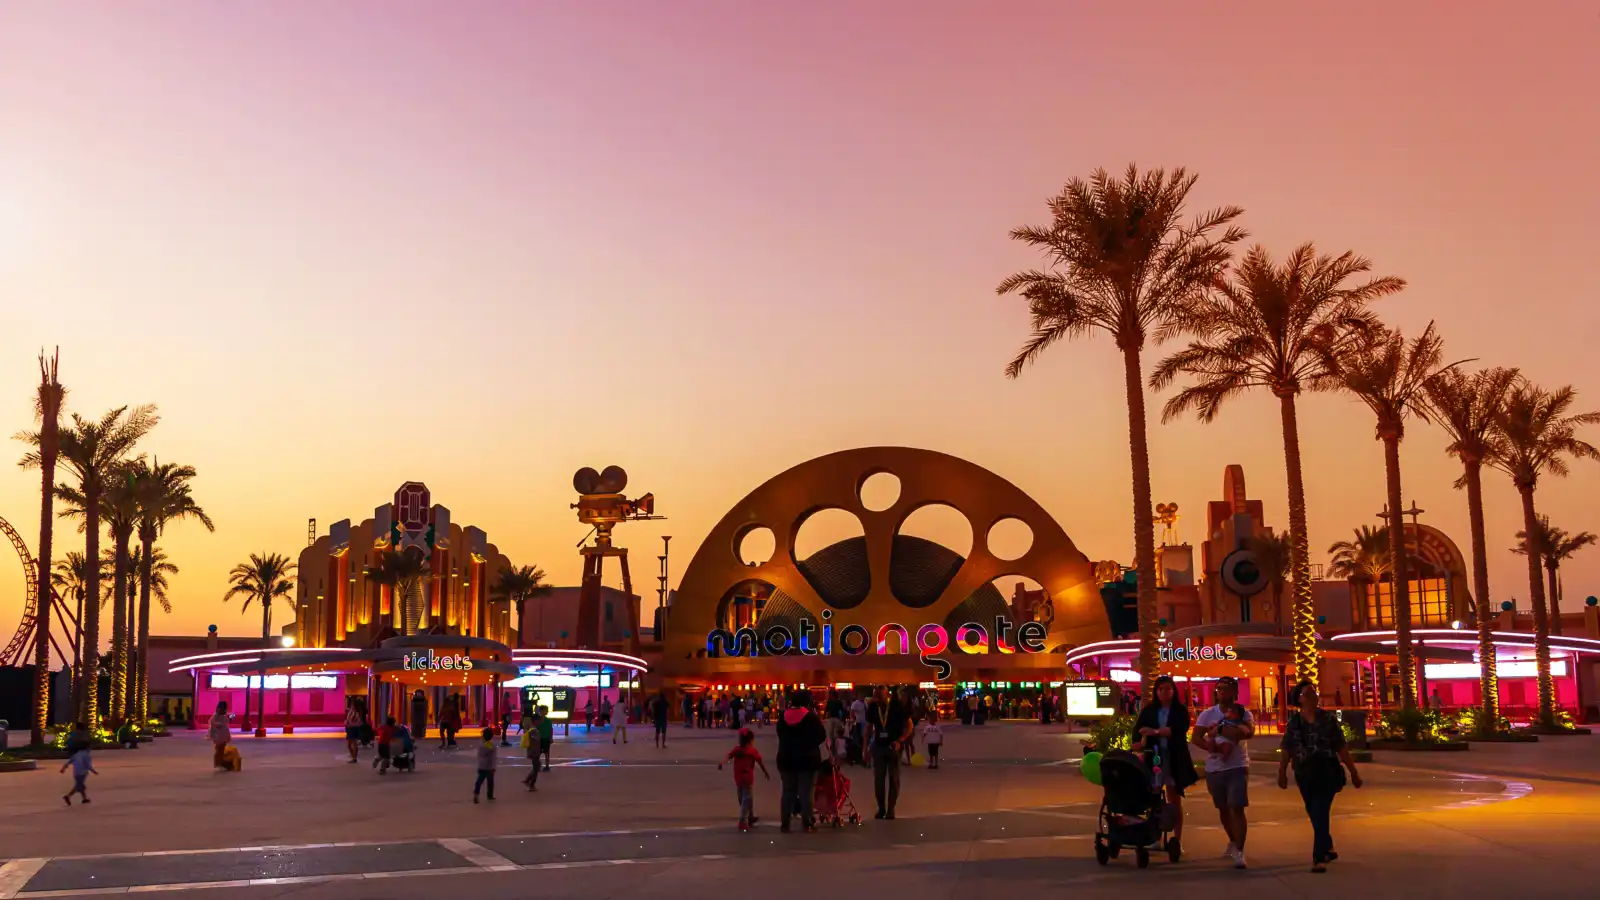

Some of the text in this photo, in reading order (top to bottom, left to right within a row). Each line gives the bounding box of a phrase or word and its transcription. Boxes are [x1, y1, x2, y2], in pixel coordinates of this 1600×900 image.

[707, 608, 1048, 680] motiongate
[1159, 637, 1237, 662] tickets
[403, 648, 473, 671] tickets
